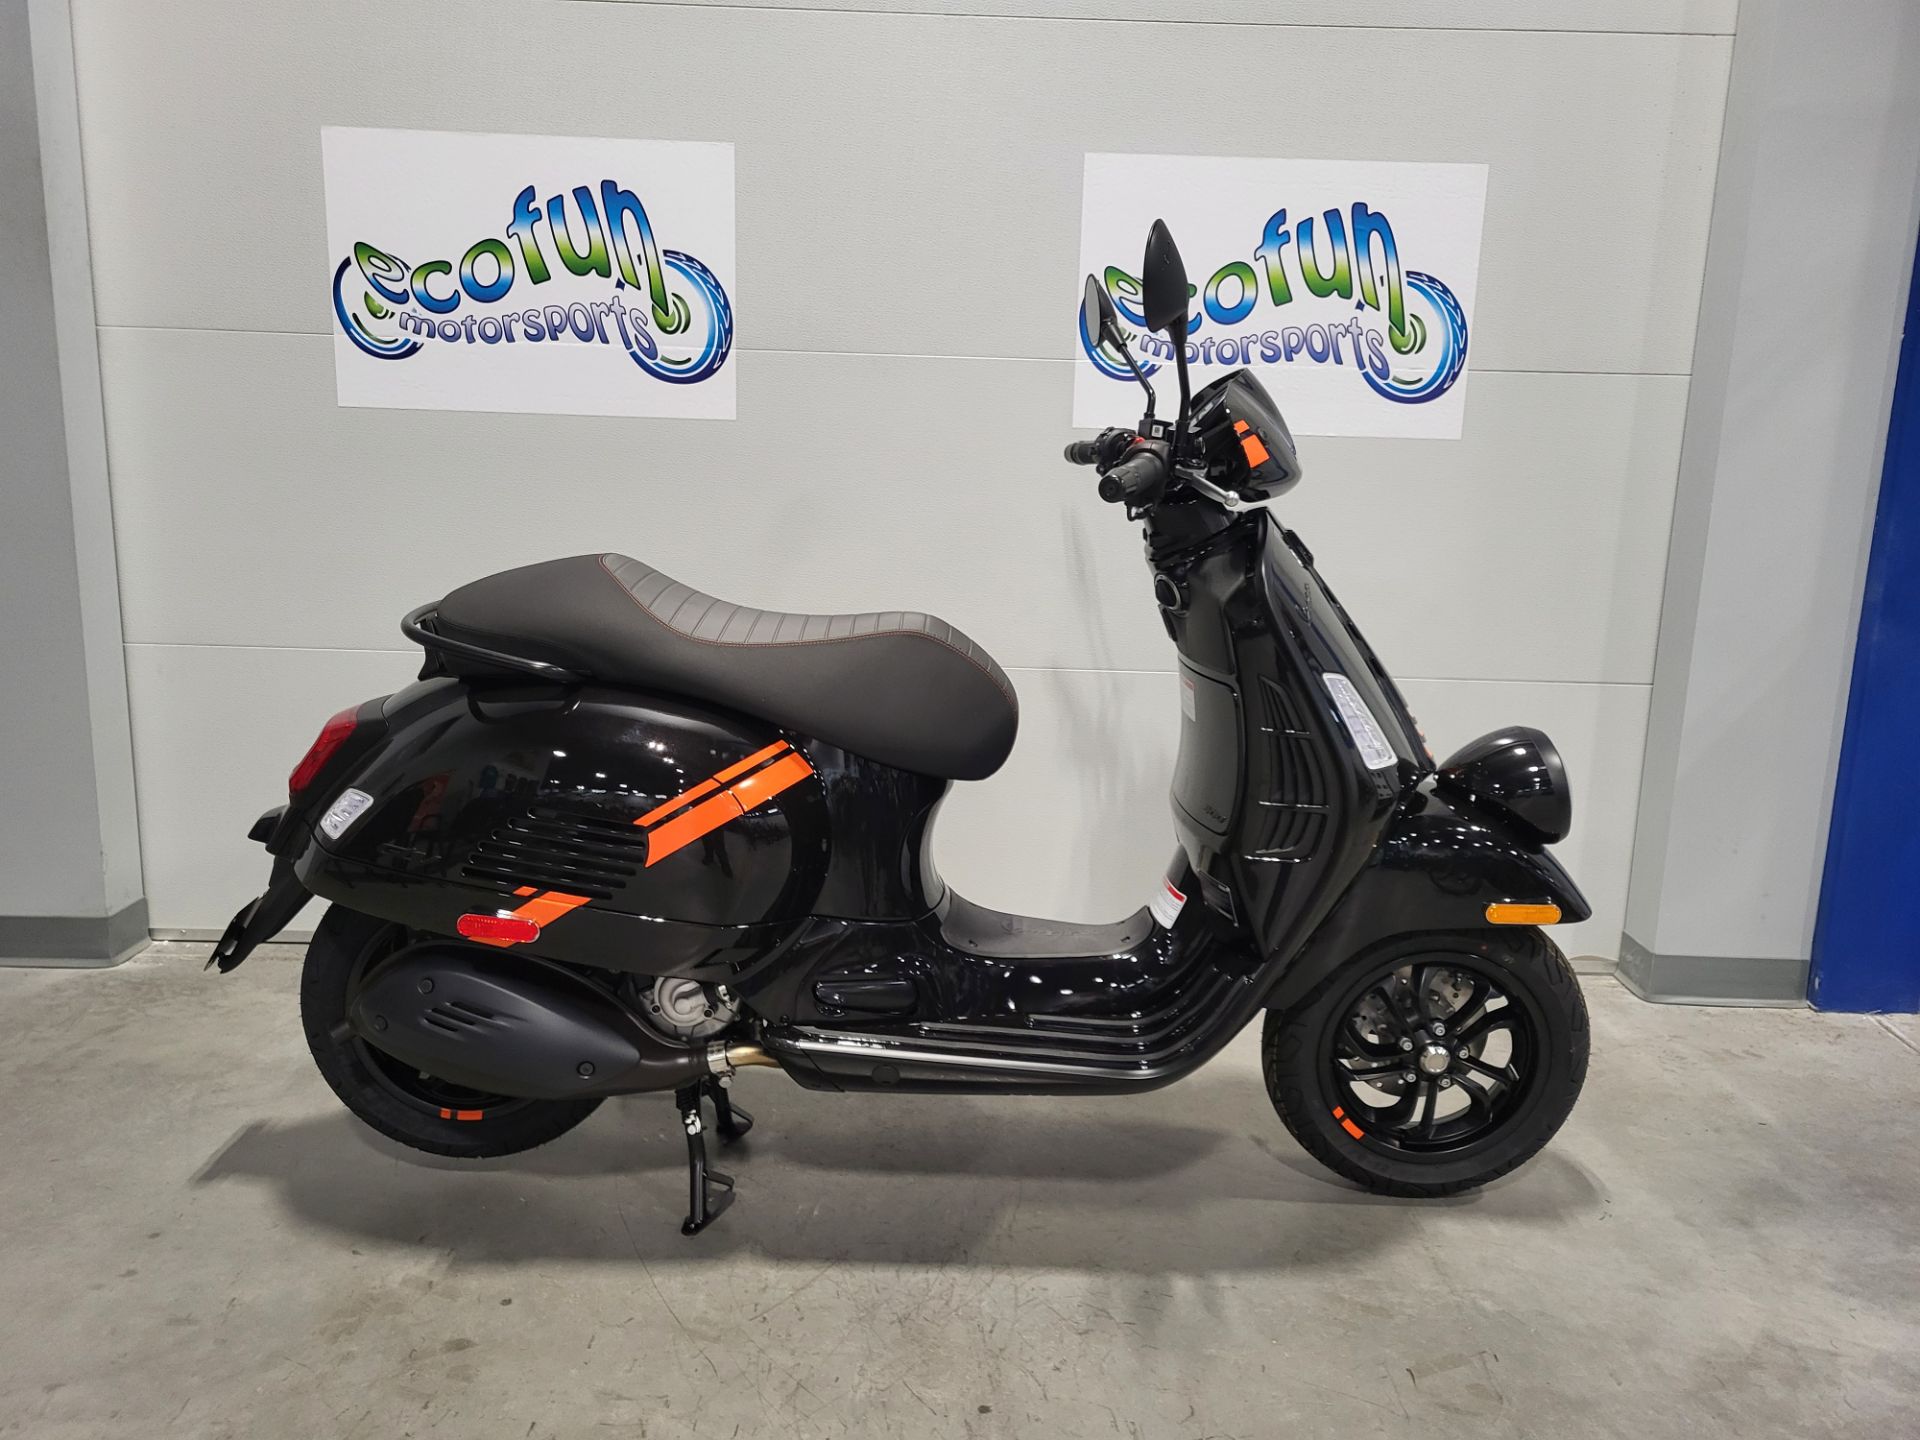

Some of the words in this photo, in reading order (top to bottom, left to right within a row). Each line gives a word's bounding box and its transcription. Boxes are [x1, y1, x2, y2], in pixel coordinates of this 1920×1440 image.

[354, 180, 669, 317] ecofun
[399, 296, 659, 361] motorsports
[1139, 316, 1390, 381] motorsports
